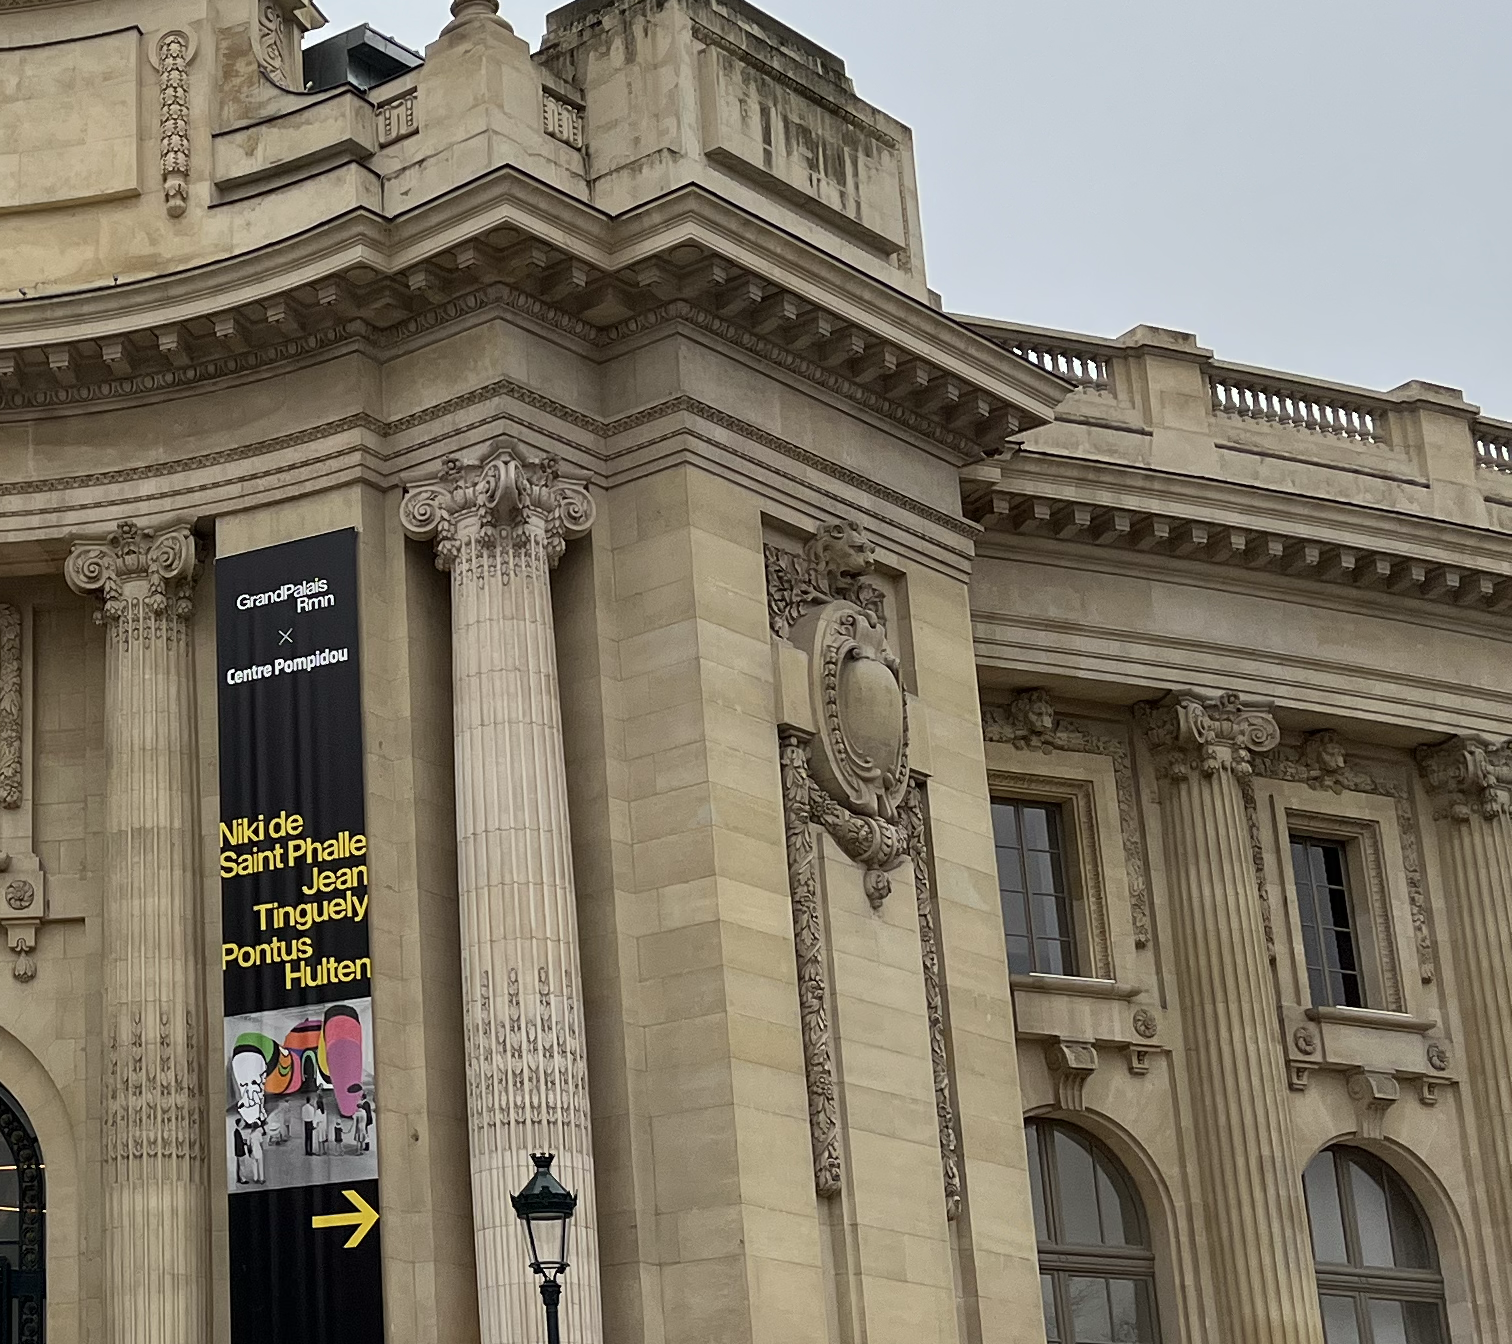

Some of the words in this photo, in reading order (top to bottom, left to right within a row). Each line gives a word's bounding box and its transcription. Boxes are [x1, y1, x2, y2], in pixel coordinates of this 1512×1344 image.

[296, 594, 335, 613] Rmn
[226, 663, 272, 685] Centre
[274, 647, 348, 675] Pompidou
[219, 814, 265, 847] Niki
[268, 810, 304, 839] de
[220, 843, 284, 878] Saint
[288, 830, 367, 867] Phalle
[301, 865, 368, 895] Jean
[253, 890, 369, 931] Tinguely
[221, 936, 313, 971] Pontus
[285, 957, 372, 990] Hulten
